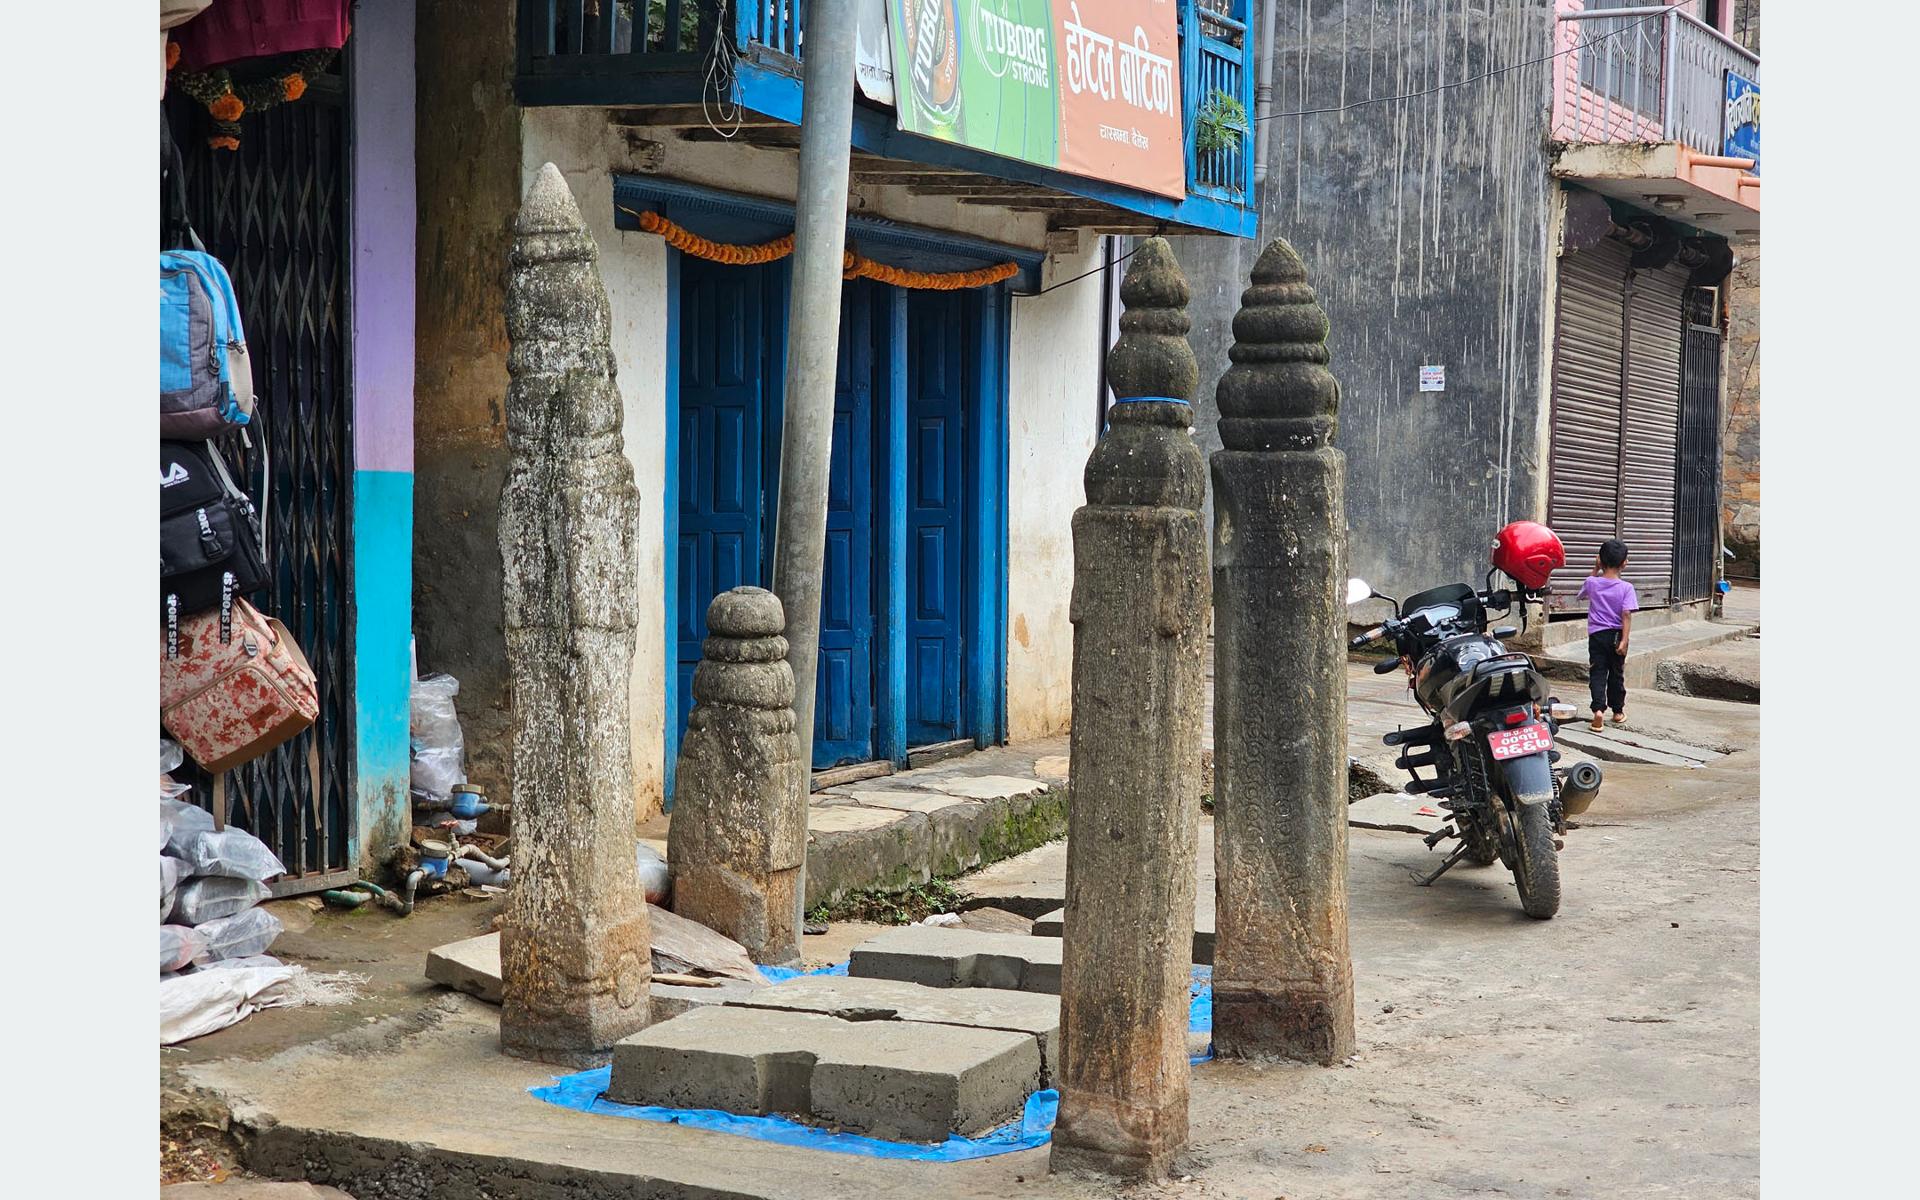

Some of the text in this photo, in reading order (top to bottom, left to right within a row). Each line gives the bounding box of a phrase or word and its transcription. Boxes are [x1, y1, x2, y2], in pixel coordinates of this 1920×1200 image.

[915, 0, 941, 94] TUBO
[980, 7, 1047, 70] TUBORG
[1012, 60, 1049, 89] STRONG
[1063, 1, 1116, 101] होटल
